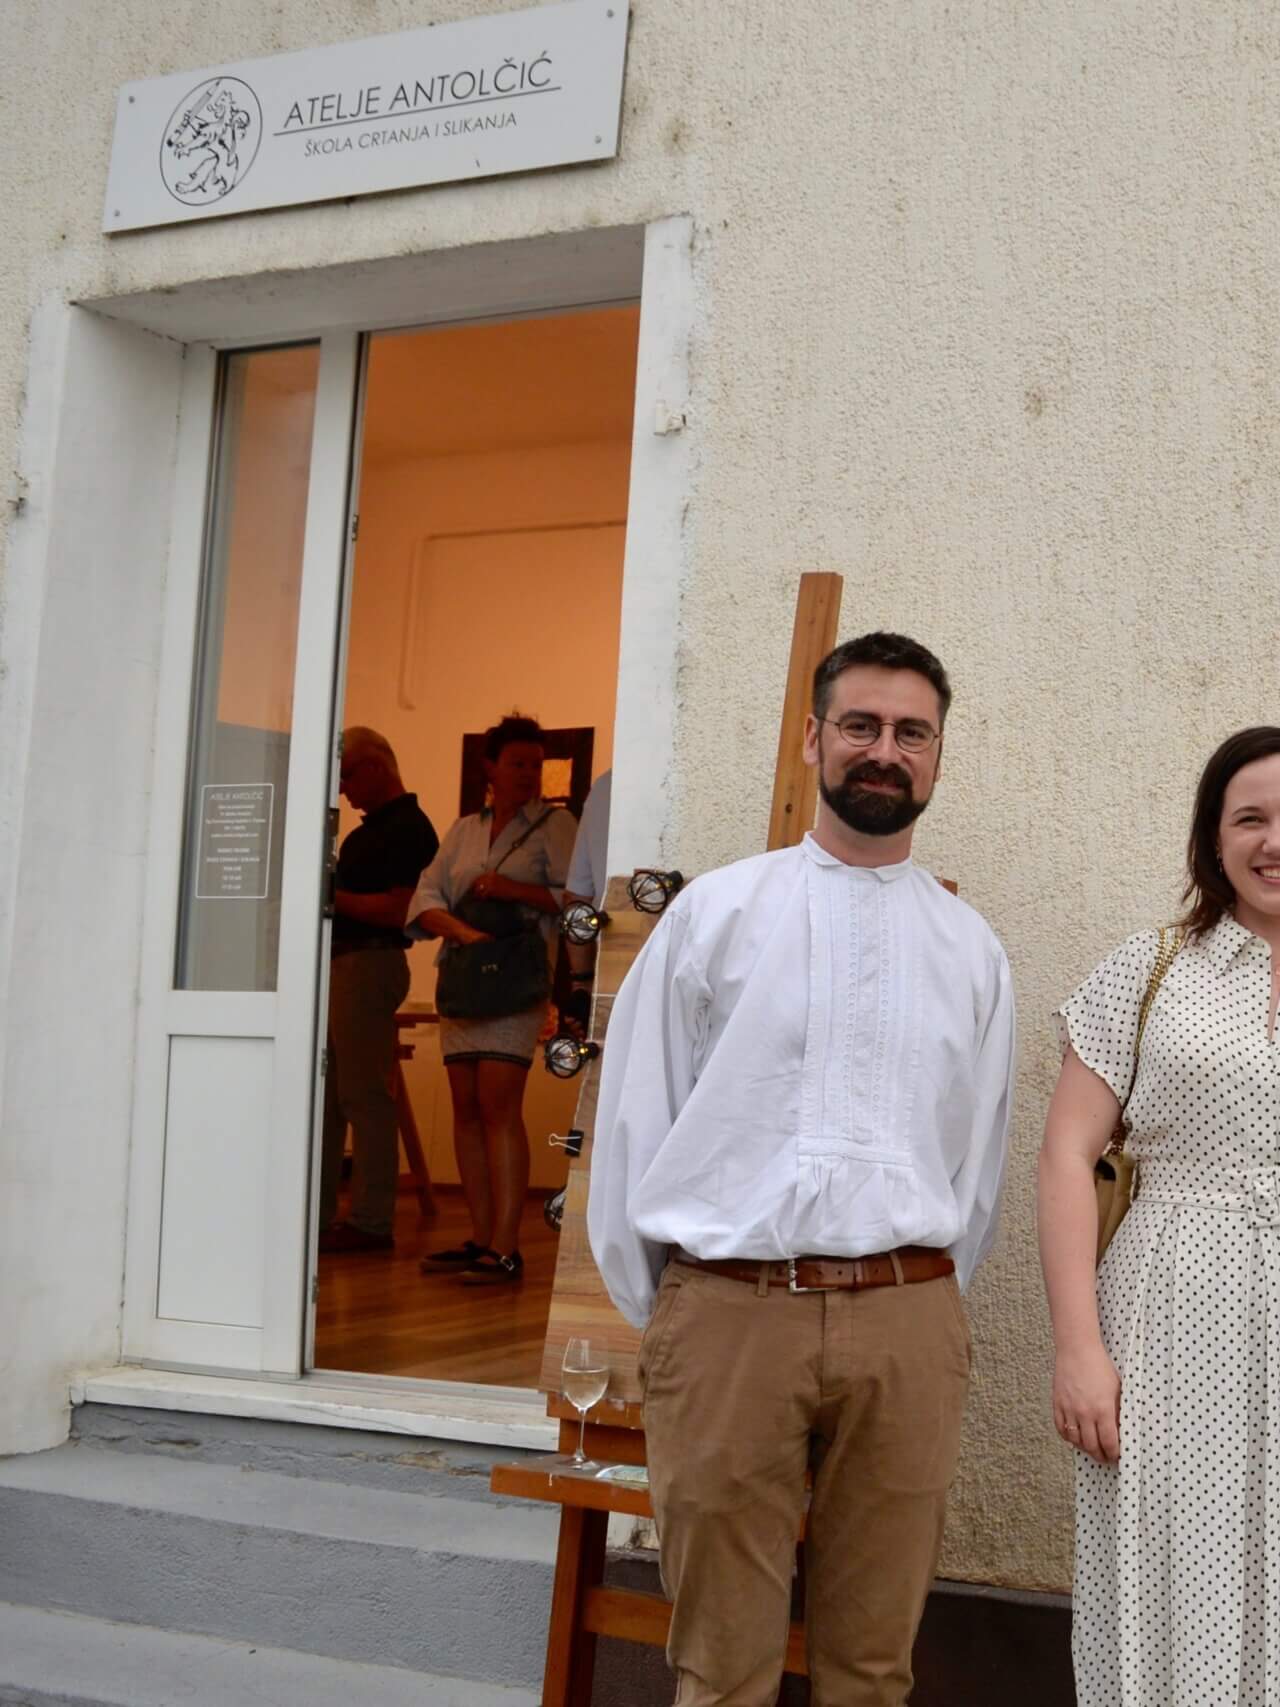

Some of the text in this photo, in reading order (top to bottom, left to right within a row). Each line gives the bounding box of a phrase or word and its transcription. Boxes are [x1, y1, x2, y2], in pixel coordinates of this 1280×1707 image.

[283, 50, 553, 128] ATELJE ANTOLČIĆ
[304, 112, 517, 157] ŠKOLA CRTANJA I SLIKANJA
